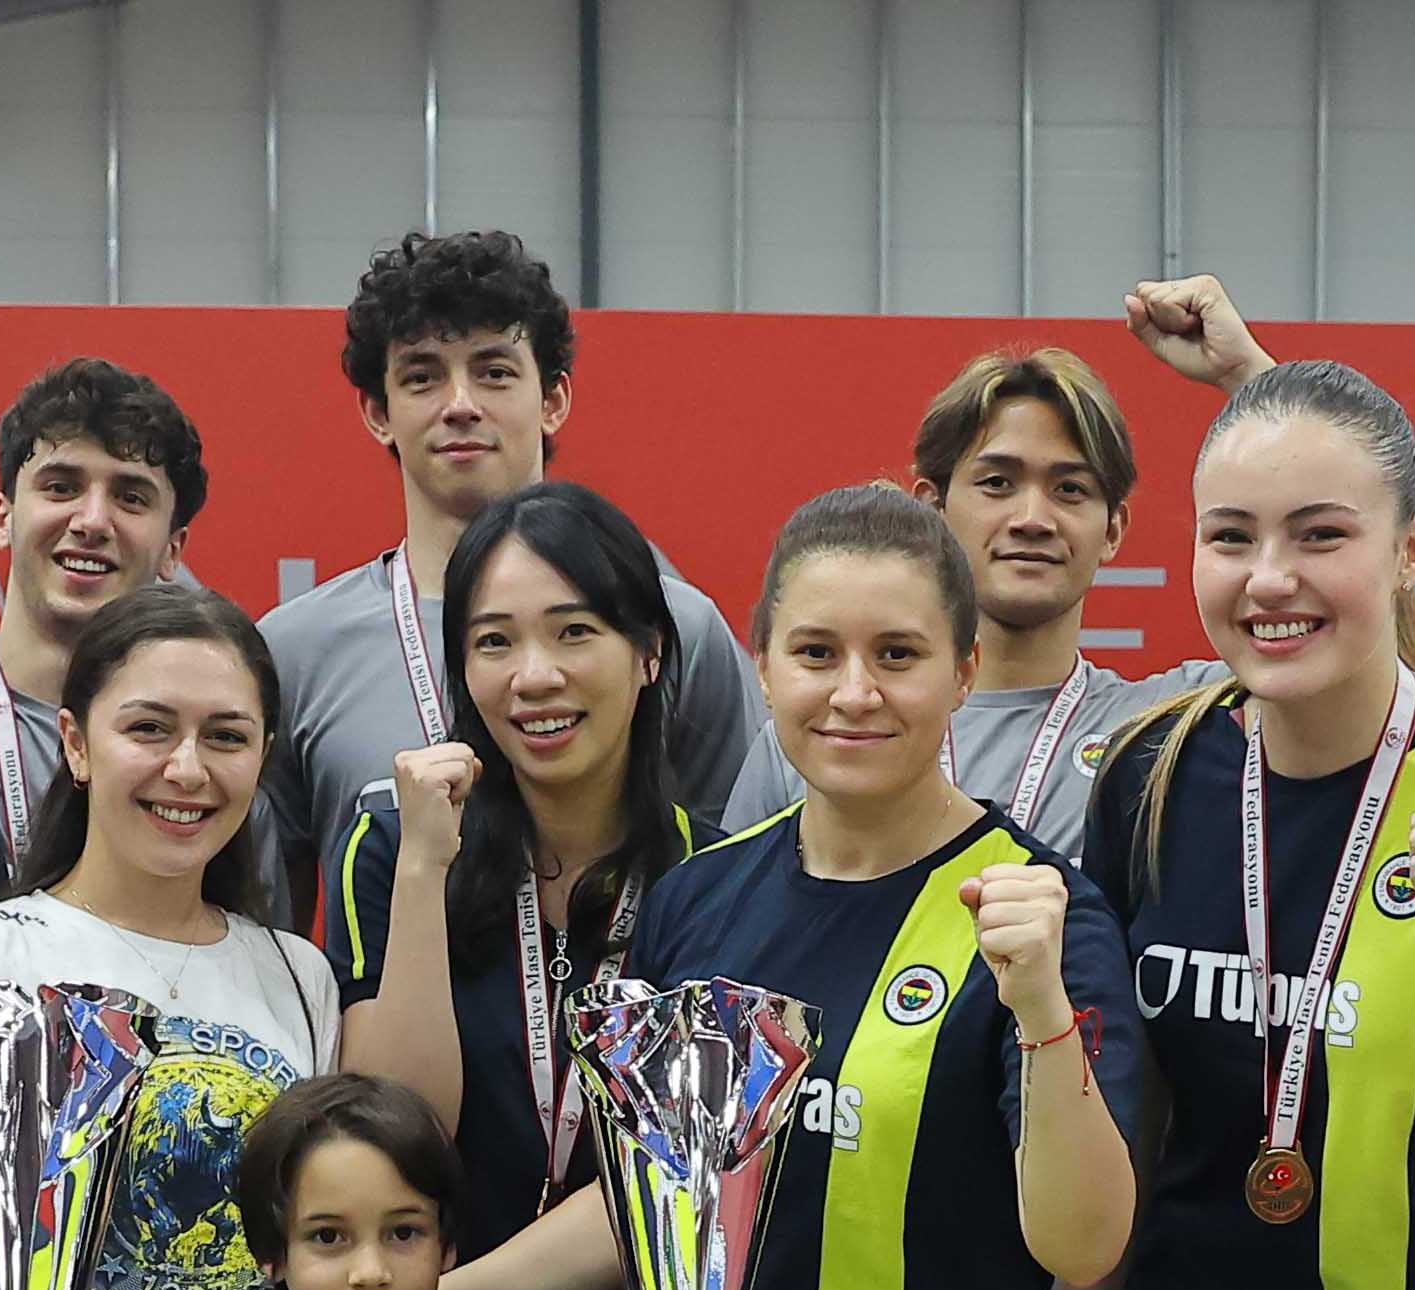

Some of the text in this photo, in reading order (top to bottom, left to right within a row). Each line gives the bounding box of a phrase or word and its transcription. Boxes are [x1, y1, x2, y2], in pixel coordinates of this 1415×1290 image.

[1244, 787, 1261, 910] Federasyonu
[518, 891, 550, 1066] Türkiye Masa Tenisi
[1277, 796, 1381, 1122] Türkiye Masa Tenisi Federasyonu
[190, 1026, 298, 1090] SPOR
